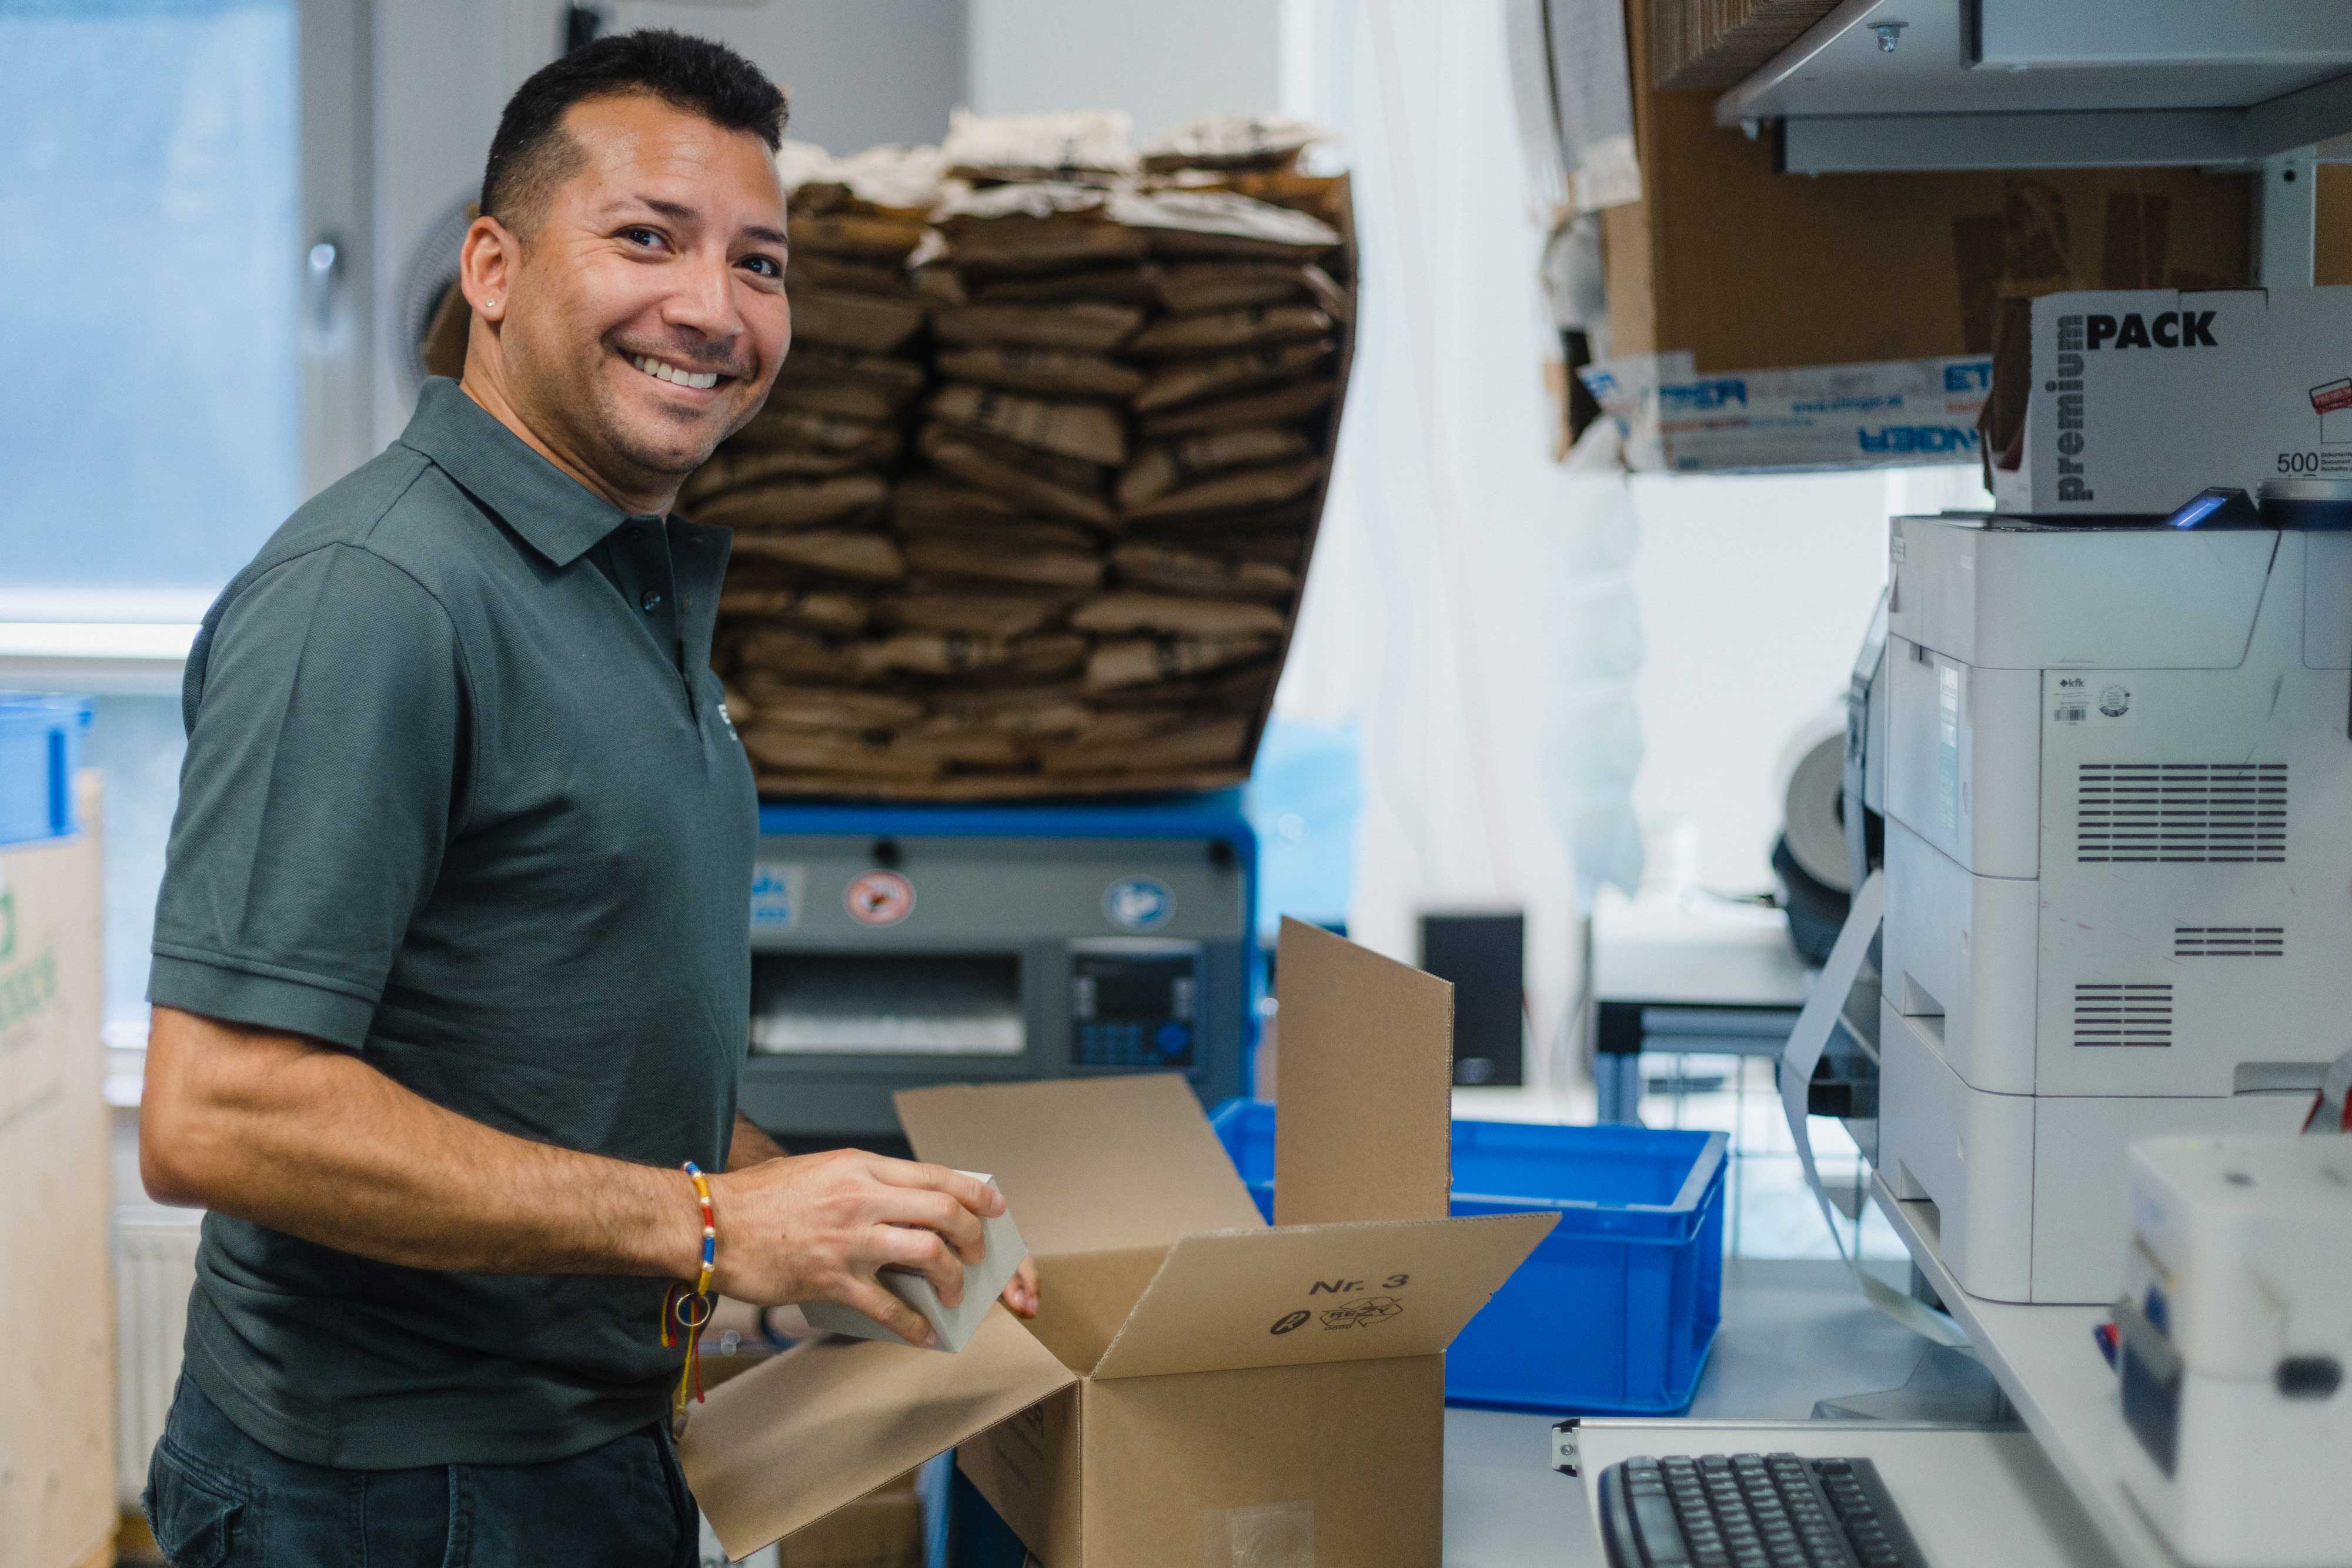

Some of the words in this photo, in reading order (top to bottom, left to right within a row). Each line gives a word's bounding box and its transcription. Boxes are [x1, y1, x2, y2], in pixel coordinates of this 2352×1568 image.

[2086, 310, 2219, 350] PACK
[2045, 315, 2093, 502] premium
[2277, 452, 2318, 472] 500
[2069, 678, 2084, 687] kfk
[1309, 1279, 1364, 1295] Nr.
[1382, 1274, 1409, 1288] 3
